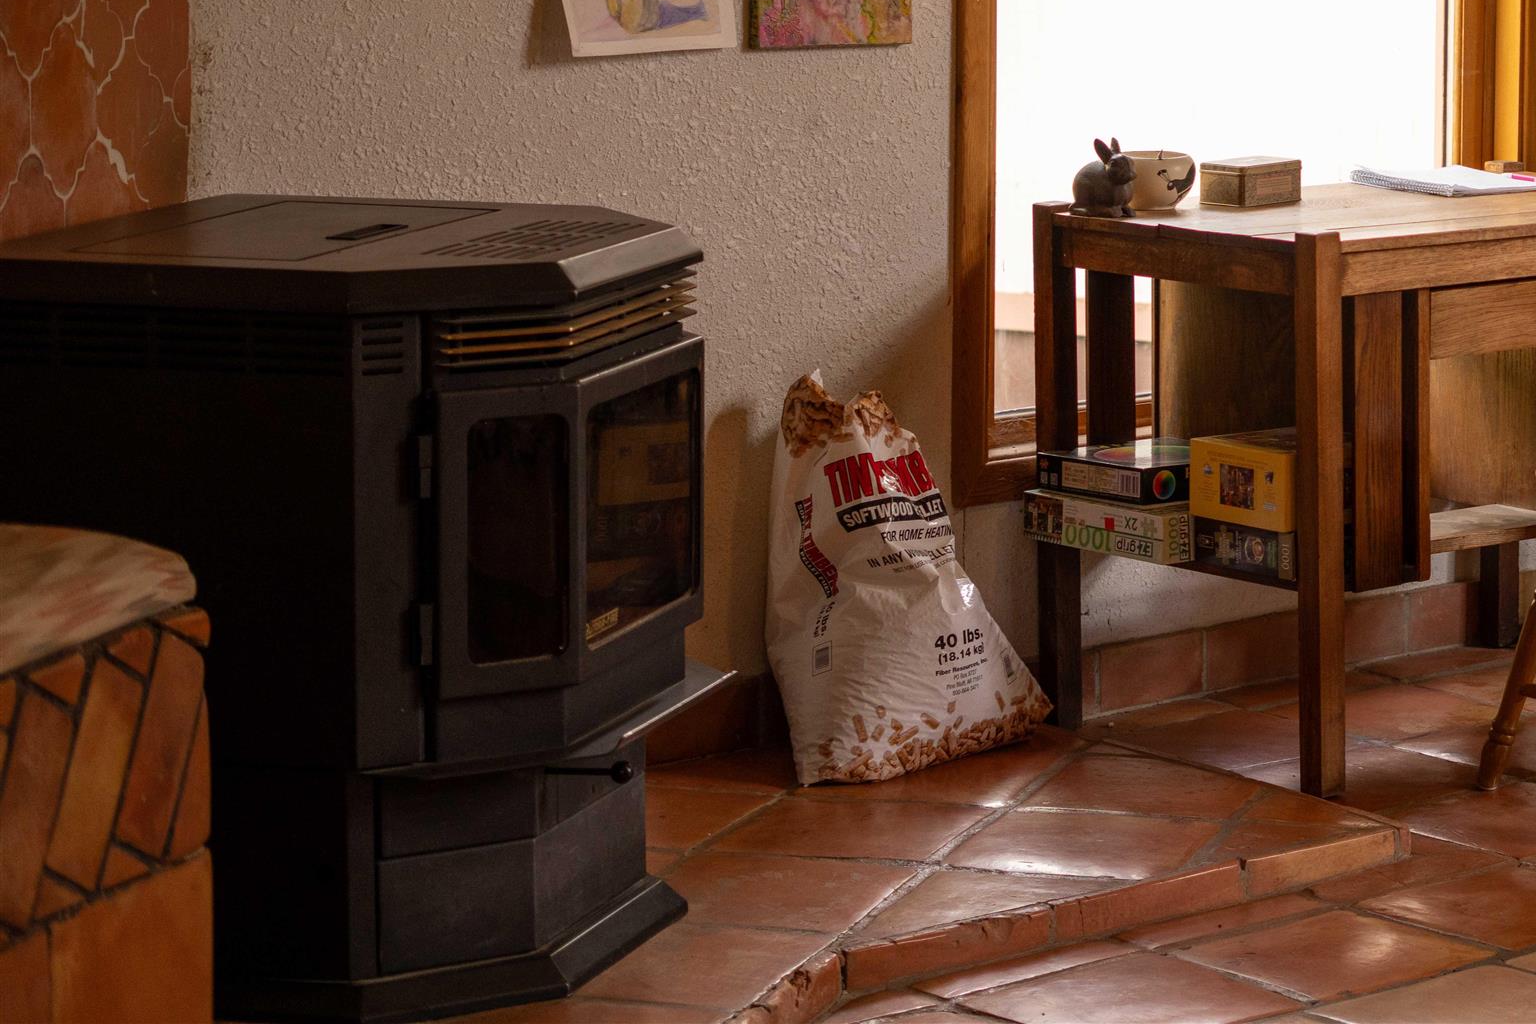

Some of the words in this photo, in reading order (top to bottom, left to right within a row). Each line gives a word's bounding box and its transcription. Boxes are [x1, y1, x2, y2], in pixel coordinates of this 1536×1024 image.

[842, 501, 914, 528] SOFTWOOD
[1124, 516, 1138, 531] 2X
[881, 530, 898, 545] FOR
[899, 527, 925, 541] HOME
[1065, 525, 1112, 553] 1000
[1169, 517, 1180, 559] 1000
[867, 558, 882, 569] IN
[882, 552, 904, 567] ANY
[934, 634, 958, 650] 40
[962, 628, 983, 644] lbs.
[938, 647, 971, 665] (18.14
[973, 641, 985, 654] kg)
[935, 669, 951, 677] Fiber
